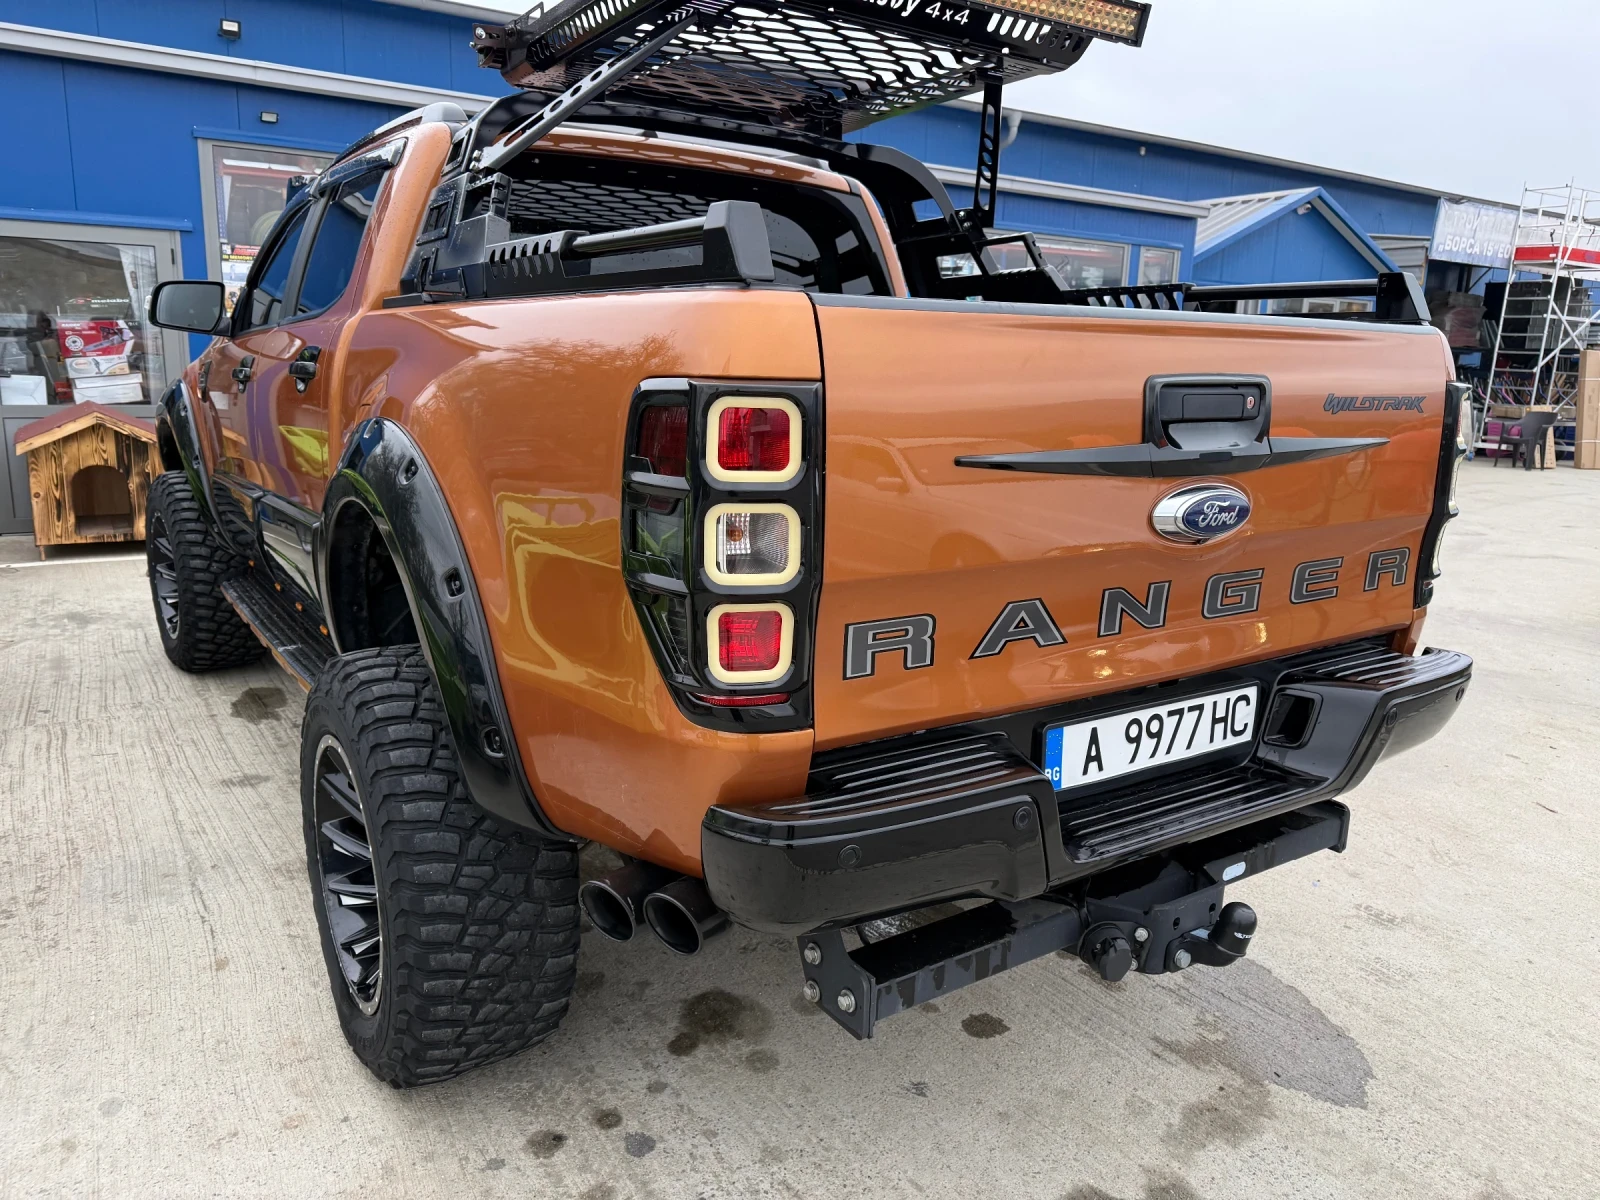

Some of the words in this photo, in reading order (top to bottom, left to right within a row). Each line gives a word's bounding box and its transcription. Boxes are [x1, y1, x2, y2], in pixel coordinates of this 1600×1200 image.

[925, 2, 970, 25] 4x4
[1323, 393, 1426, 415] WILDTRAK
[1196, 501, 1239, 528] Ford
[843, 547, 1410, 680] RANGER
[1082, 726, 1104, 776] A
[1044, 766, 1060, 782] BG
